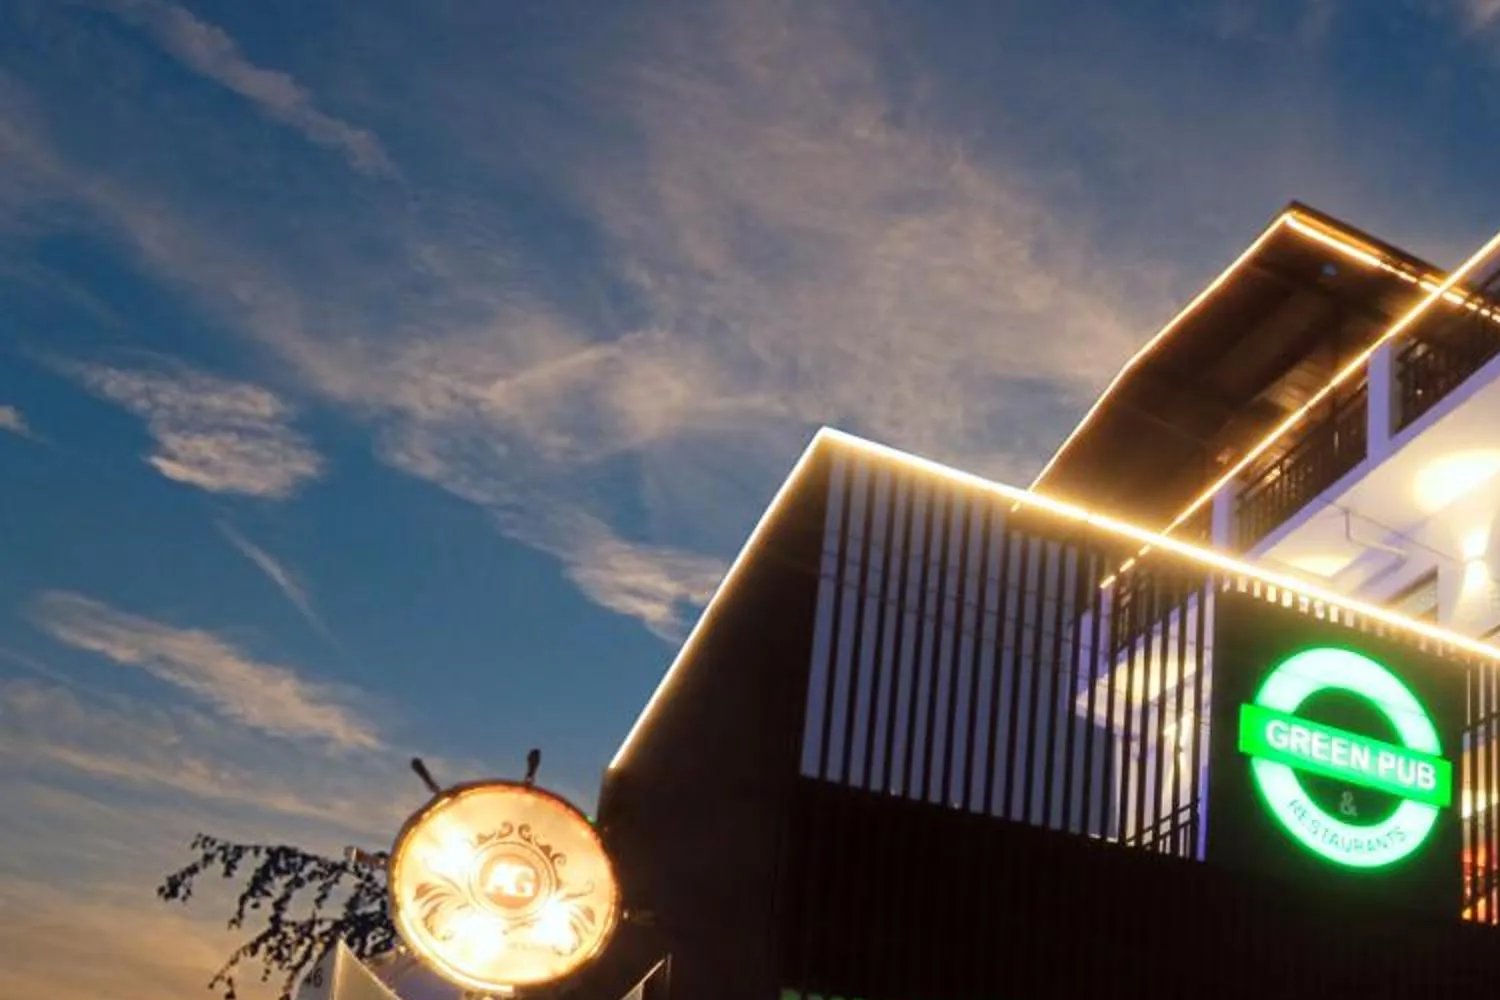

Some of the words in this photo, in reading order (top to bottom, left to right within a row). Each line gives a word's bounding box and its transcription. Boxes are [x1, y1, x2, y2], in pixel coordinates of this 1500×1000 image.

[1265, 719, 1371, 771] GREEN
[1377, 749, 1437, 790] PUB
[1340, 789, 1358, 816] &
